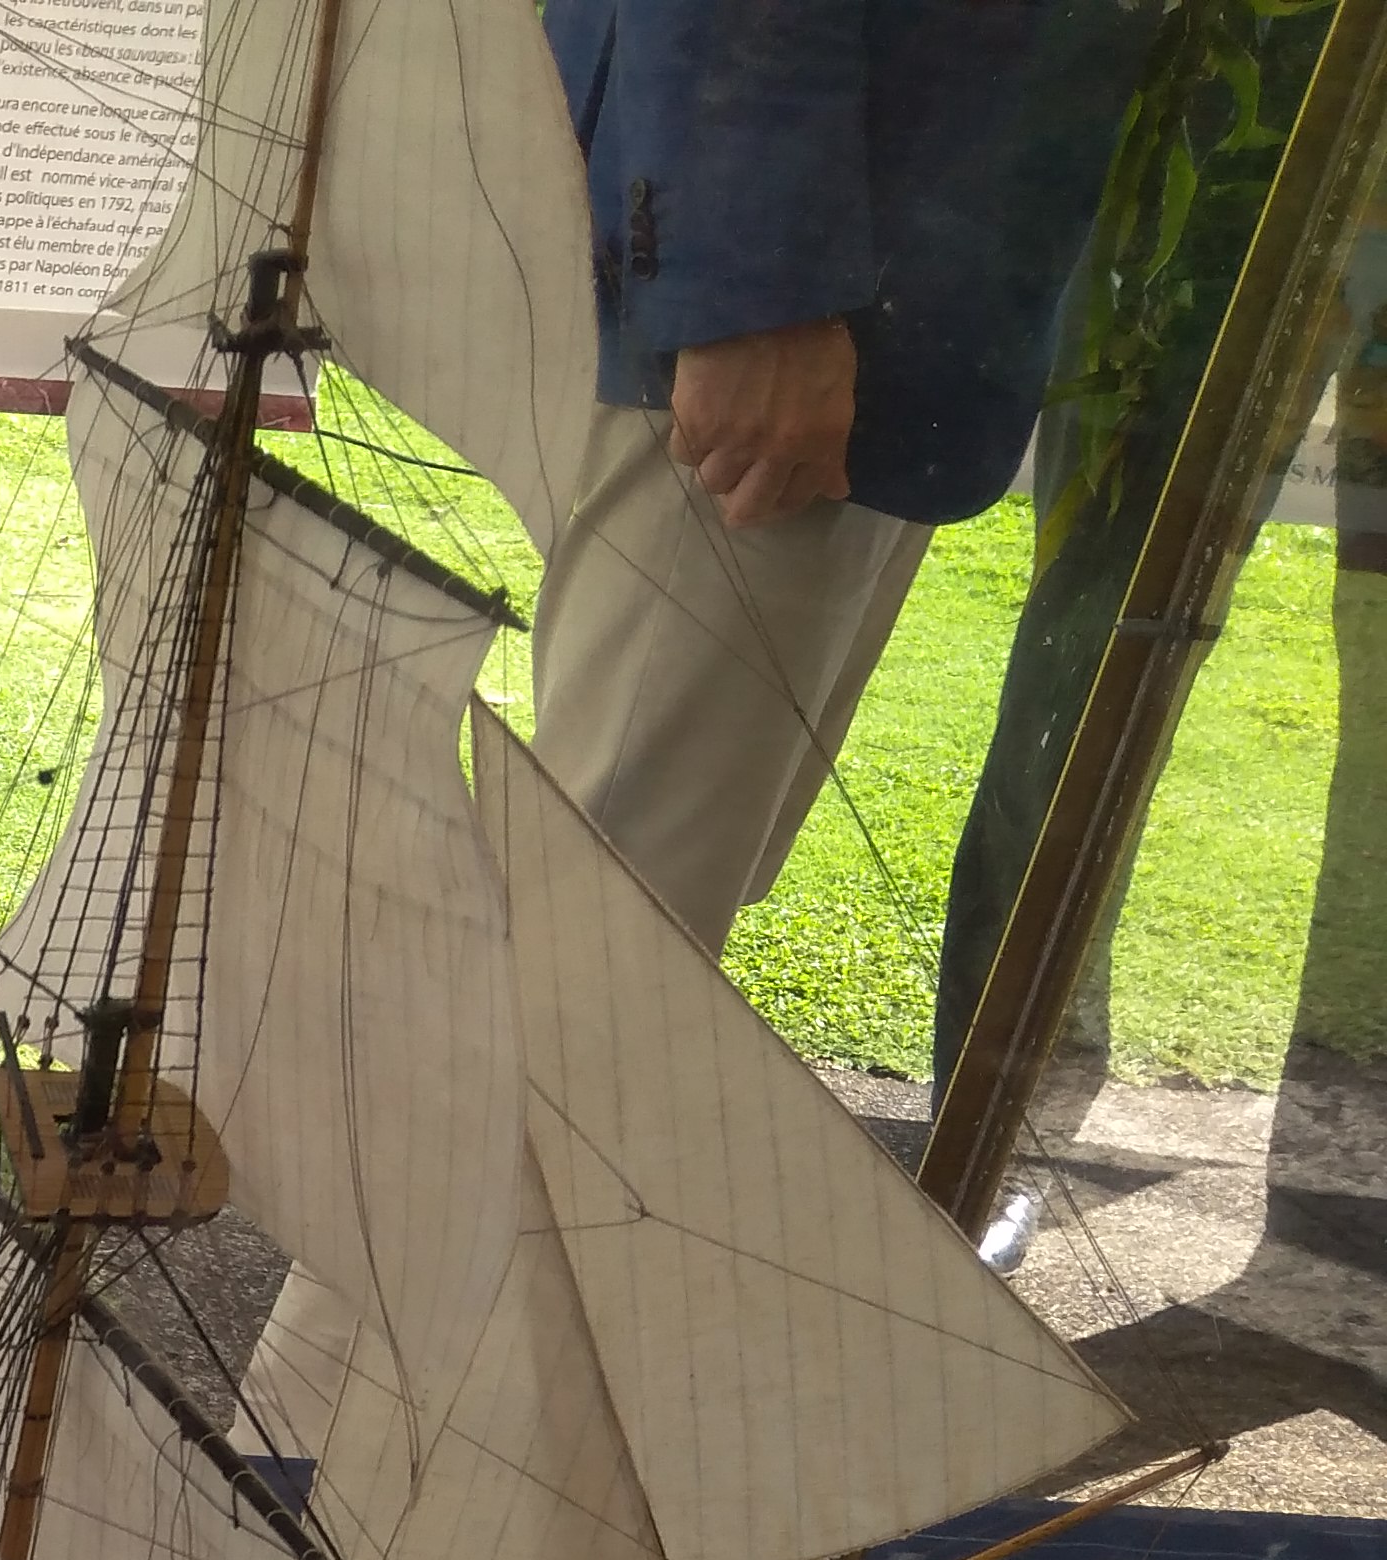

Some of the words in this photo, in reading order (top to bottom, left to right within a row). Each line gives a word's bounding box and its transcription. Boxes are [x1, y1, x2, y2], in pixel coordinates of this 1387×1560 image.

[141, 21, 174, 37] dont
[178, 24, 197, 39] les
[55, 40, 72, 56] les
[21, 99, 69, 115] encore
[71, 103, 99, 117] une
[25, 121, 80, 138] effectué
[84, 129, 115, 141] sous
[11, 168, 32, 182] est
[41, 172, 96, 185] nommé
[99, 172, 174, 192] vice-amiral
[5, 191, 74, 210] politiques
[78, 197, 96, 209] en
[101, 196, 135, 213] 1792,
[13, 233, 35, 250] élu
[38, 236, 94, 256] membre
[9, 258, 32, 273] par
[35, 260, 101, 277] Napoléon
[33, 283, 46, 296] et
[49, 283, 74, 296] son
